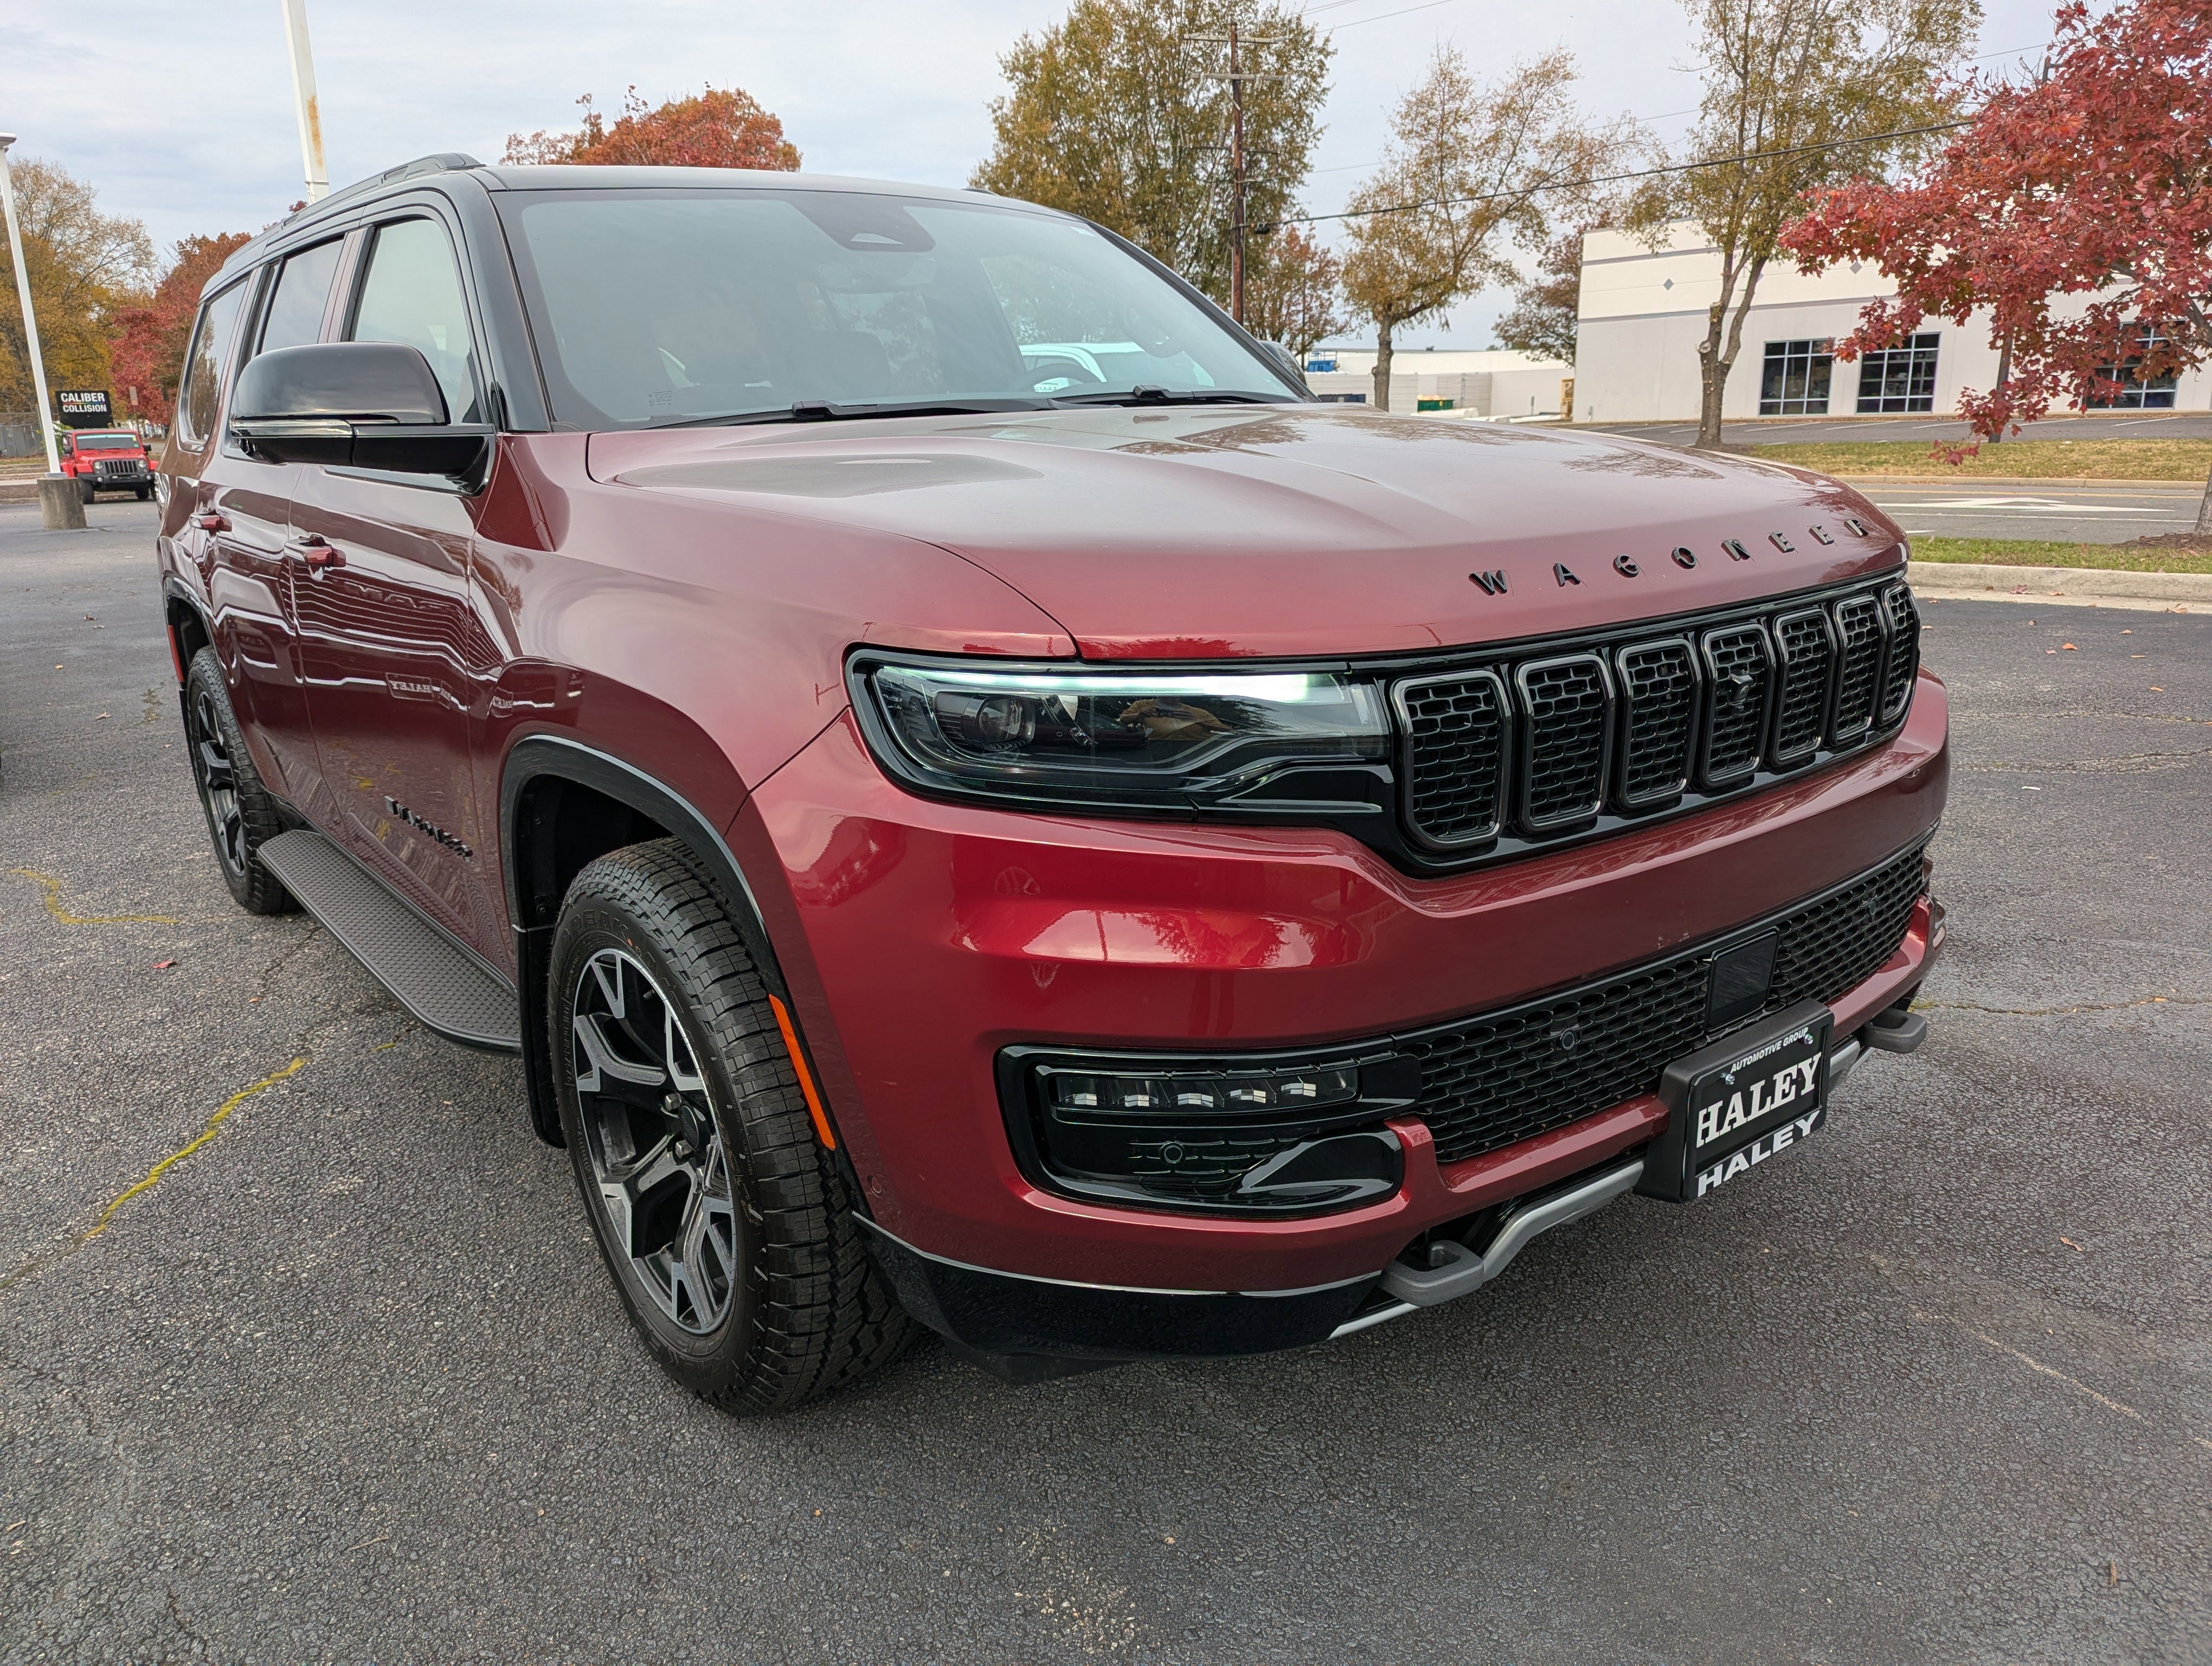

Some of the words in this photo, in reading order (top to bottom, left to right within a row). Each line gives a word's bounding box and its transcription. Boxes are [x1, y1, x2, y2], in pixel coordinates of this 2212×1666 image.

[61, 393, 105, 402] CALIBER
[62, 404, 107, 413] COLLISION
[1468, 518, 1869, 596] WAGONEER
[1729, 1040, 1783, 1074] AUTOMOTIVE
[1783, 1027, 1809, 1047] GROUP
[1696, 1052, 1822, 1149] HALEY
[1697, 1110, 1821, 1197] HALEY
